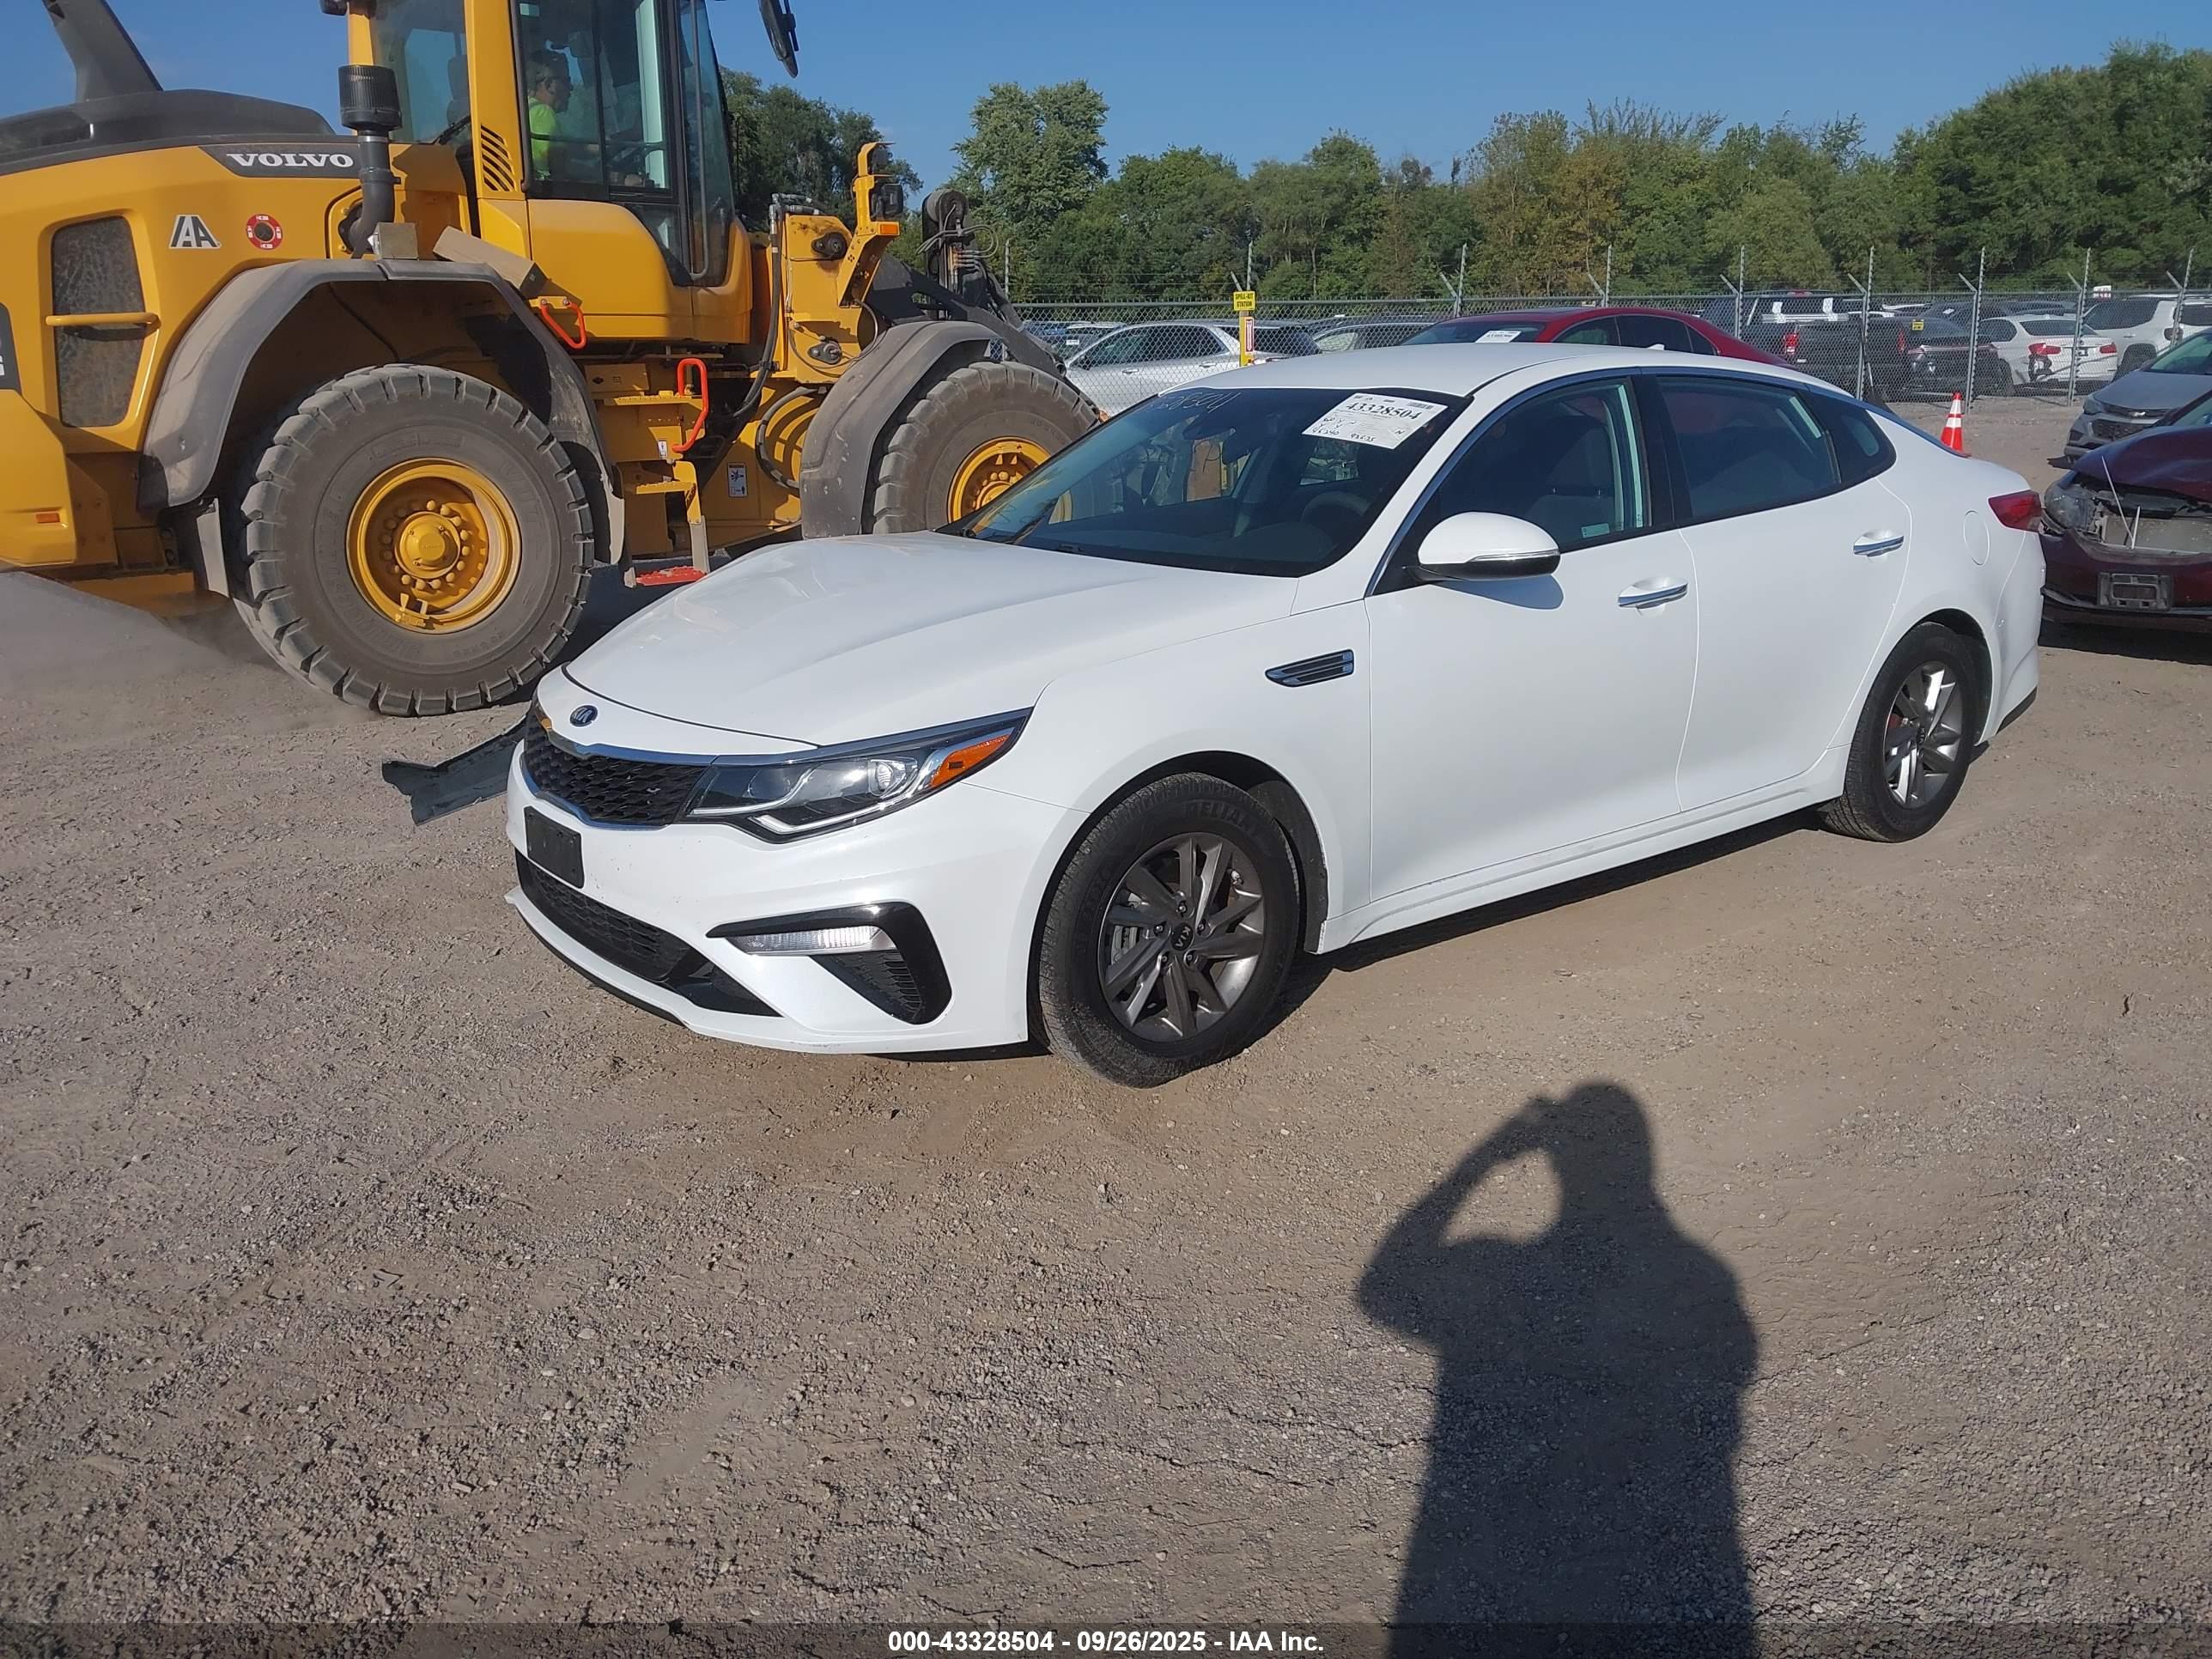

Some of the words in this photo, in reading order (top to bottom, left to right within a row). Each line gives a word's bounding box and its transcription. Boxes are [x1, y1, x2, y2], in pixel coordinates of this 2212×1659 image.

[227, 153, 355, 168] VOLVO
[1346, 401, 1423, 420] 43328504
[1175, 925, 1191, 947] KIA
